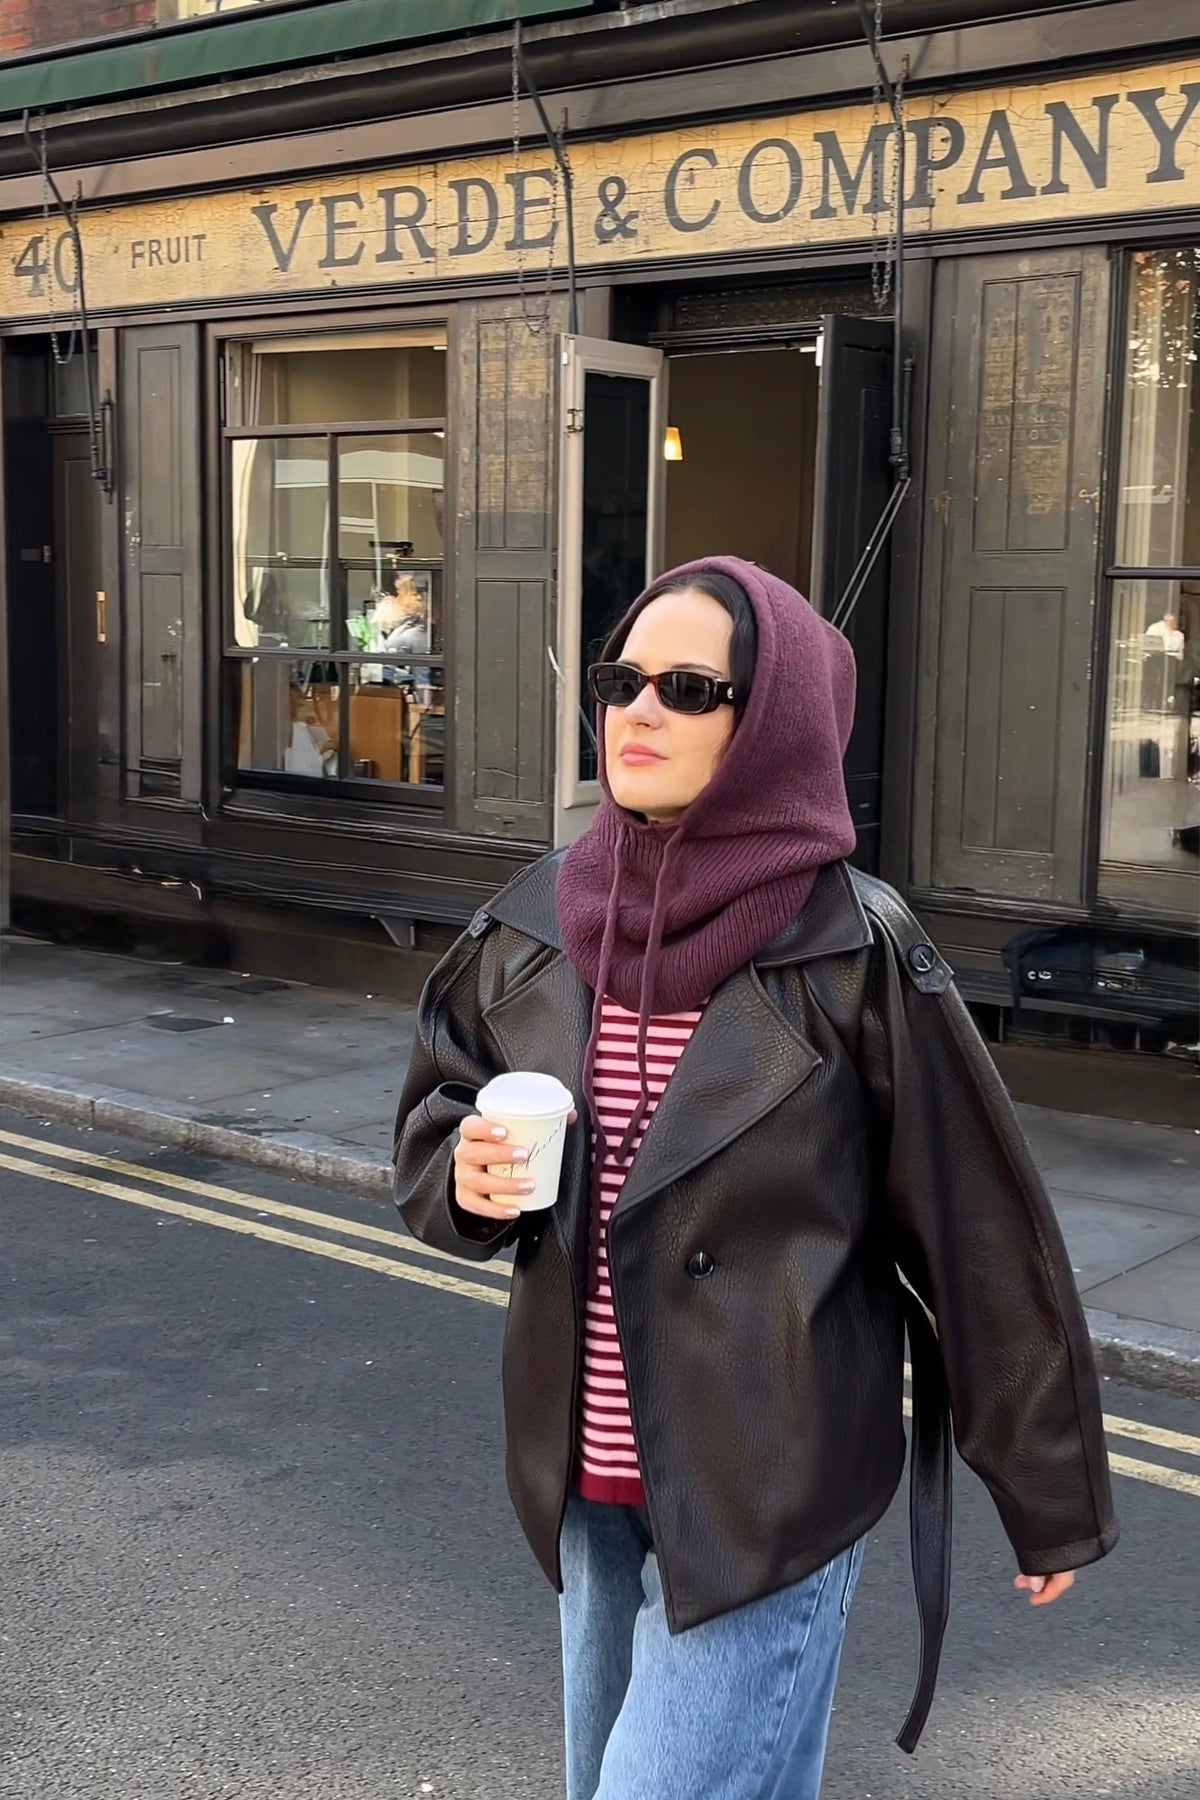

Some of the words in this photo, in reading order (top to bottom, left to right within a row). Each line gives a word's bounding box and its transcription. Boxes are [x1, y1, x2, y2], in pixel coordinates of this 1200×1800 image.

[251, 168, 560, 272] VERDE
[595, 176, 639, 245] &
[664, 82, 1200, 233] COMPANY
[14, 231, 81, 297] 40
[131, 234, 207, 268] FRUIT
